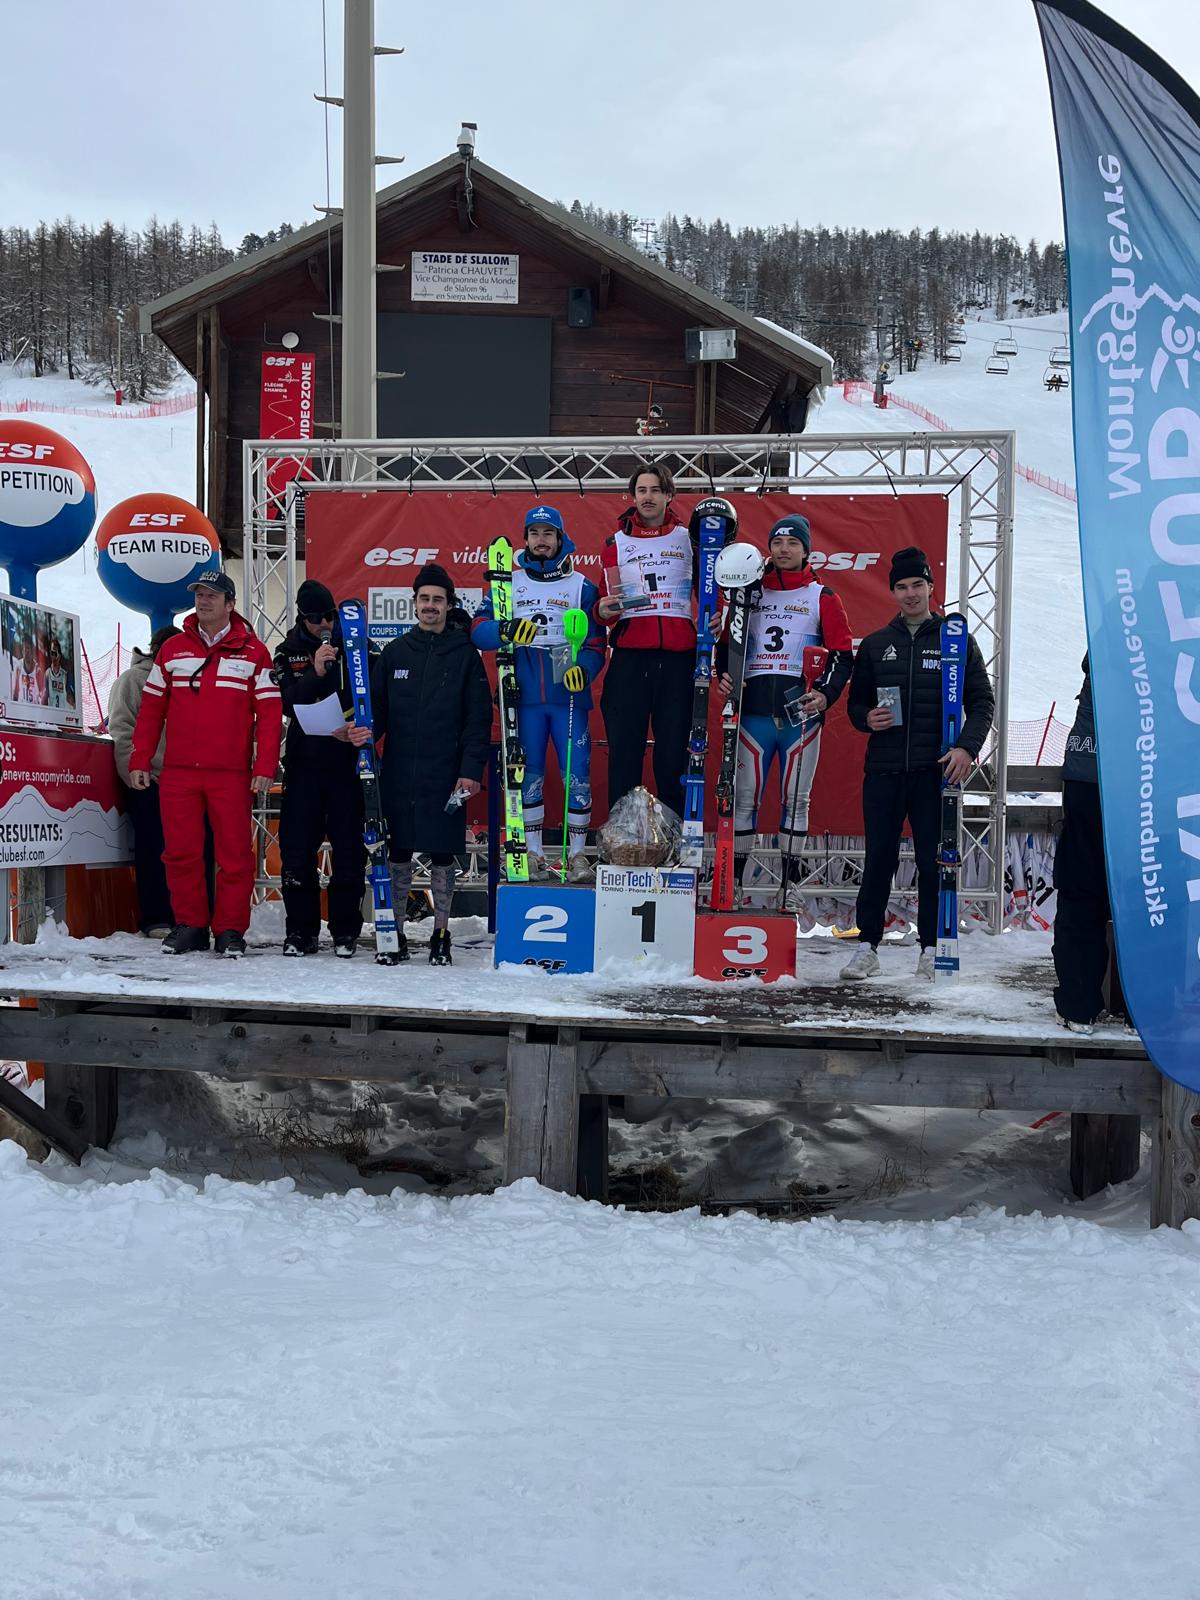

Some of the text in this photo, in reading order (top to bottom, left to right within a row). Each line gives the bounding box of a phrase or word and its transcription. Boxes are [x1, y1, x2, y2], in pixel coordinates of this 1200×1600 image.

[422, 254, 509, 266] STADE DE SLALOM
[415, 275, 516, 285] Vice Championne du Monde
[444, 284, 487, 293] de Slalom 96
[446, 293, 466, 301] Sierra
[467, 293, 493, 301] Nevada
[265, 356, 295, 367] esf
[129, 513, 187, 527] ESF
[109, 539, 210, 557] TEAM RIDER
[452, 545, 489, 564] vide
[364, 547, 440, 566] esf
[569, 554, 601, 566] ww
[806, 550, 881, 571] esf
[641, 560, 671, 568] TOUR
[543, 571, 562, 579] uvex
[371, 627, 398, 636] COUPES
[756, 653, 791, 661] HOMME
[0, 845, 45, 863] lubesf.com
[601, 870, 652, 888] EnerTech
[522, 905, 569, 943] 2
[631, 900, 657, 943] 1
[722, 926, 769, 964] 3
[721, 966, 768, 979] esf
